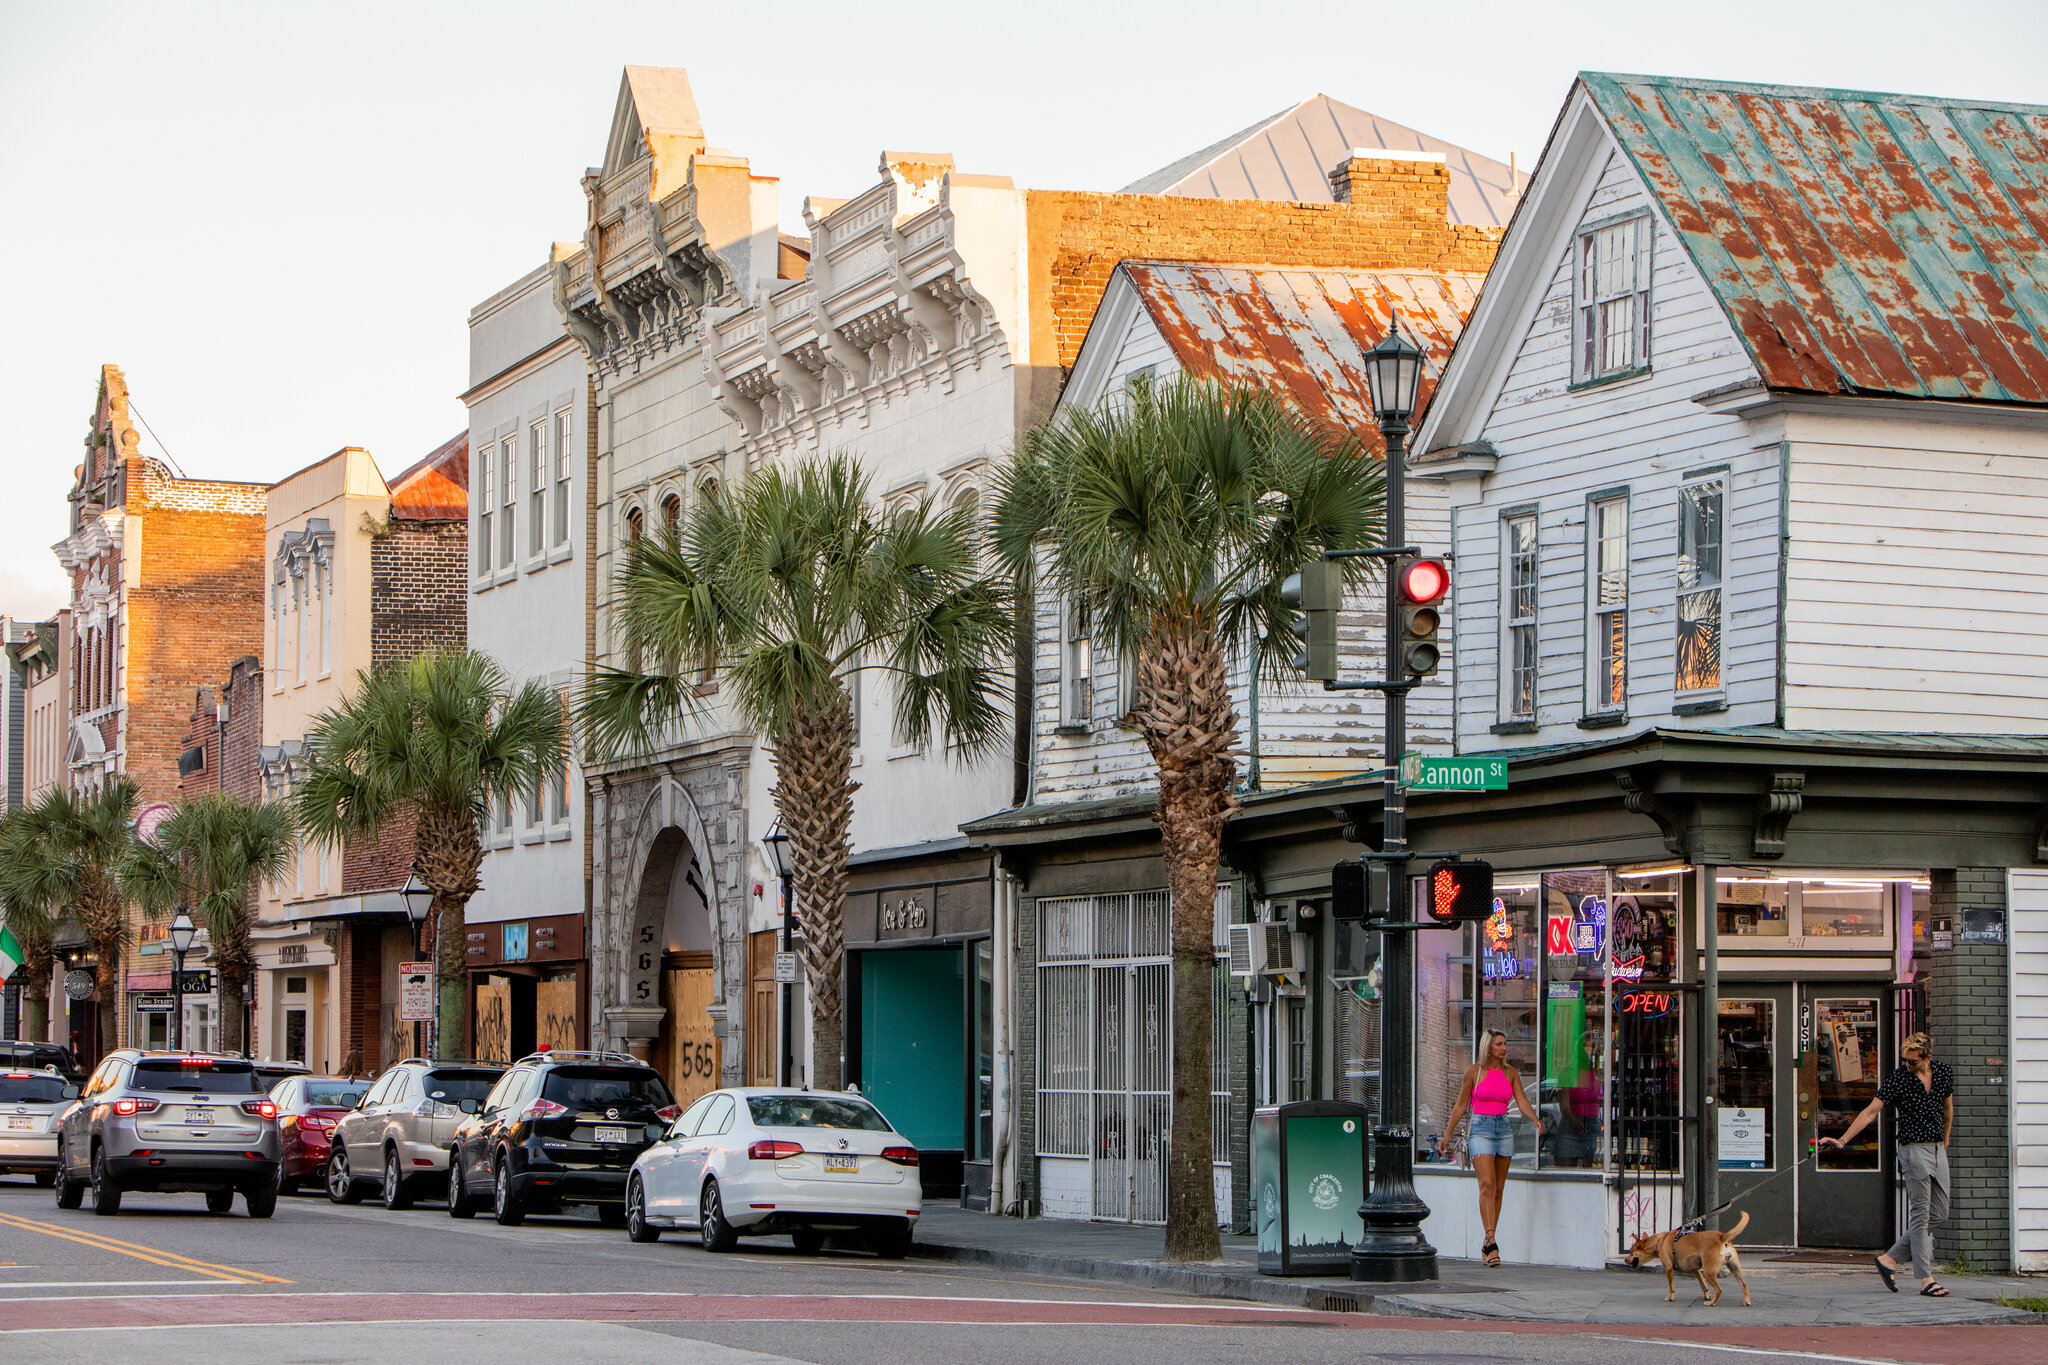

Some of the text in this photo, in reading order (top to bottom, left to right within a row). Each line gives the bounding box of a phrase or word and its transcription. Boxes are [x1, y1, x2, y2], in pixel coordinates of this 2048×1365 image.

[1490, 763, 1502, 777] St
[883, 903, 895, 930] Ice
[898, 900, 907, 929] &
[1580, 925, 1594, 937] BUD
[1578, 937, 1595, 949] LIGHT
[401, 965, 410, 973] NO
[636, 925, 655, 1000] 565
[1483, 947, 1517, 977] Mdelo
[71, 982, 86, 990] 549
[177, 982, 207, 991] OGA
[1622, 993, 1670, 1012] OPEN
[1801, 1006, 1809, 1051] PUSH
[682, 1041, 713, 1078] 565
[1320, 1174, 1342, 1192] CHARLESTON
